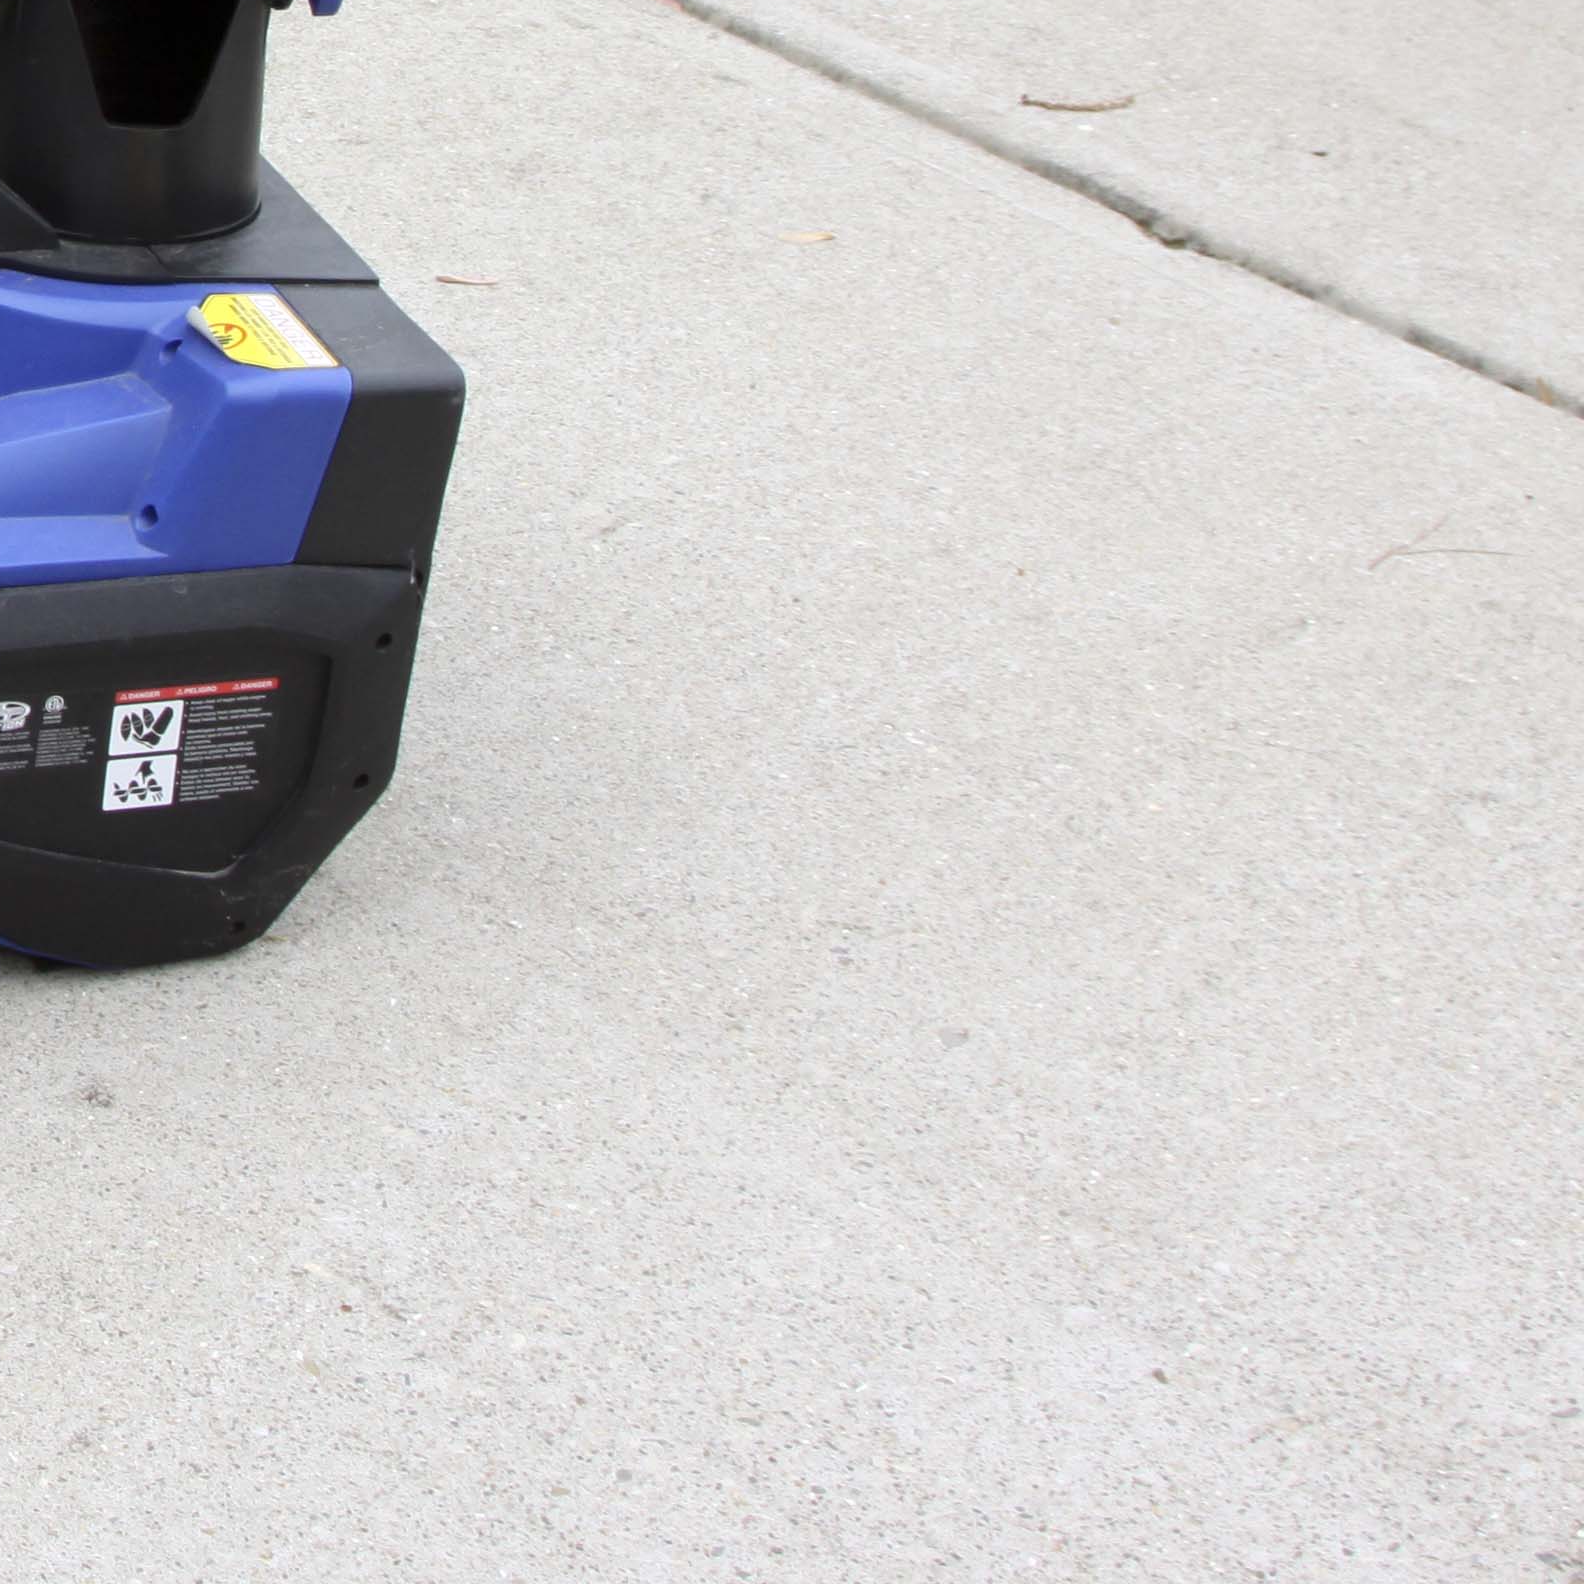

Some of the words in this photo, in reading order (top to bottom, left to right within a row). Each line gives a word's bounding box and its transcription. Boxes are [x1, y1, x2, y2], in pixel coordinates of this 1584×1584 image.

[254, 298, 324, 361] DANGER
[183, 685, 217, 695] PELIGRO
[240, 680, 273, 690] DANGER
[128, 690, 161, 700] DANGER
